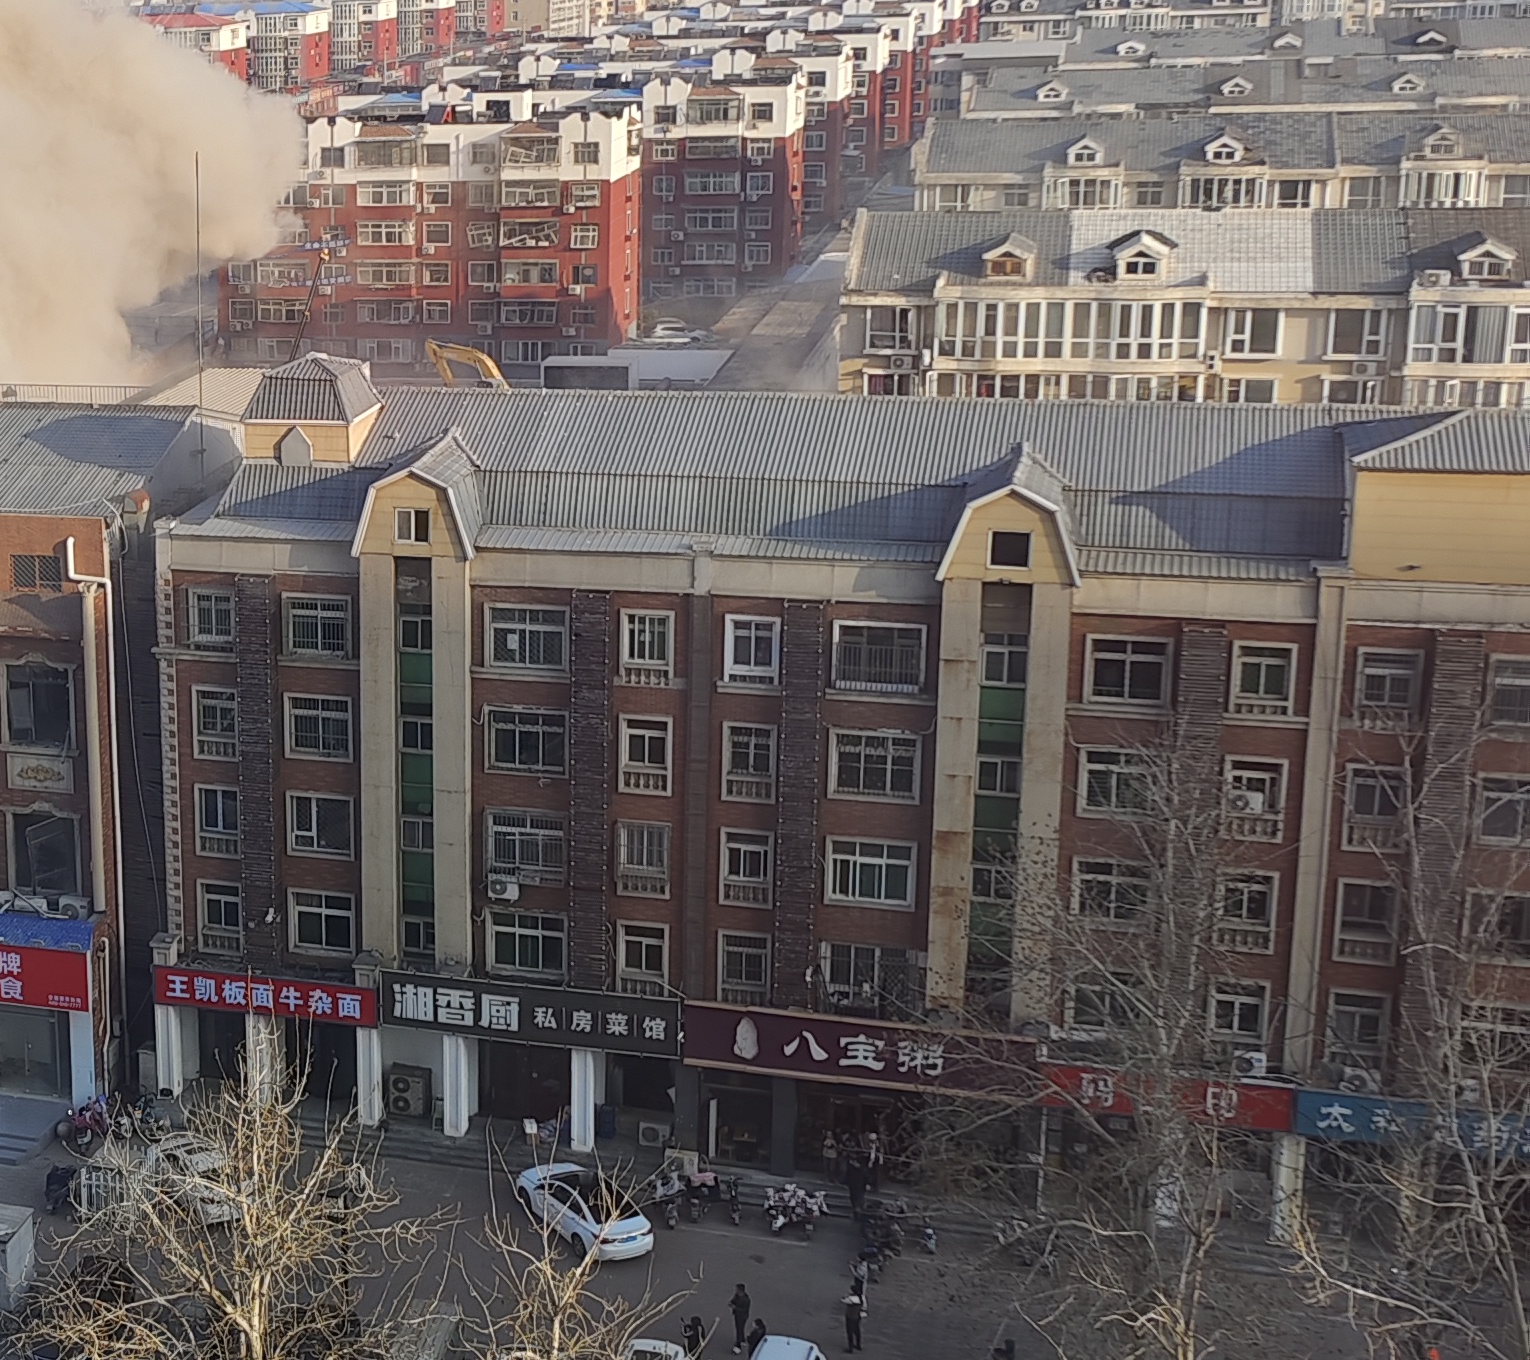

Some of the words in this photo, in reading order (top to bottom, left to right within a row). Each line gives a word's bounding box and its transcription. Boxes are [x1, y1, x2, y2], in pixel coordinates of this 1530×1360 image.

[165, 973, 363, 1020] 王凯板面牛杂面
[391, 982, 521, 1032] 湘香厨
[783, 1029, 945, 1078] 八宝粥
